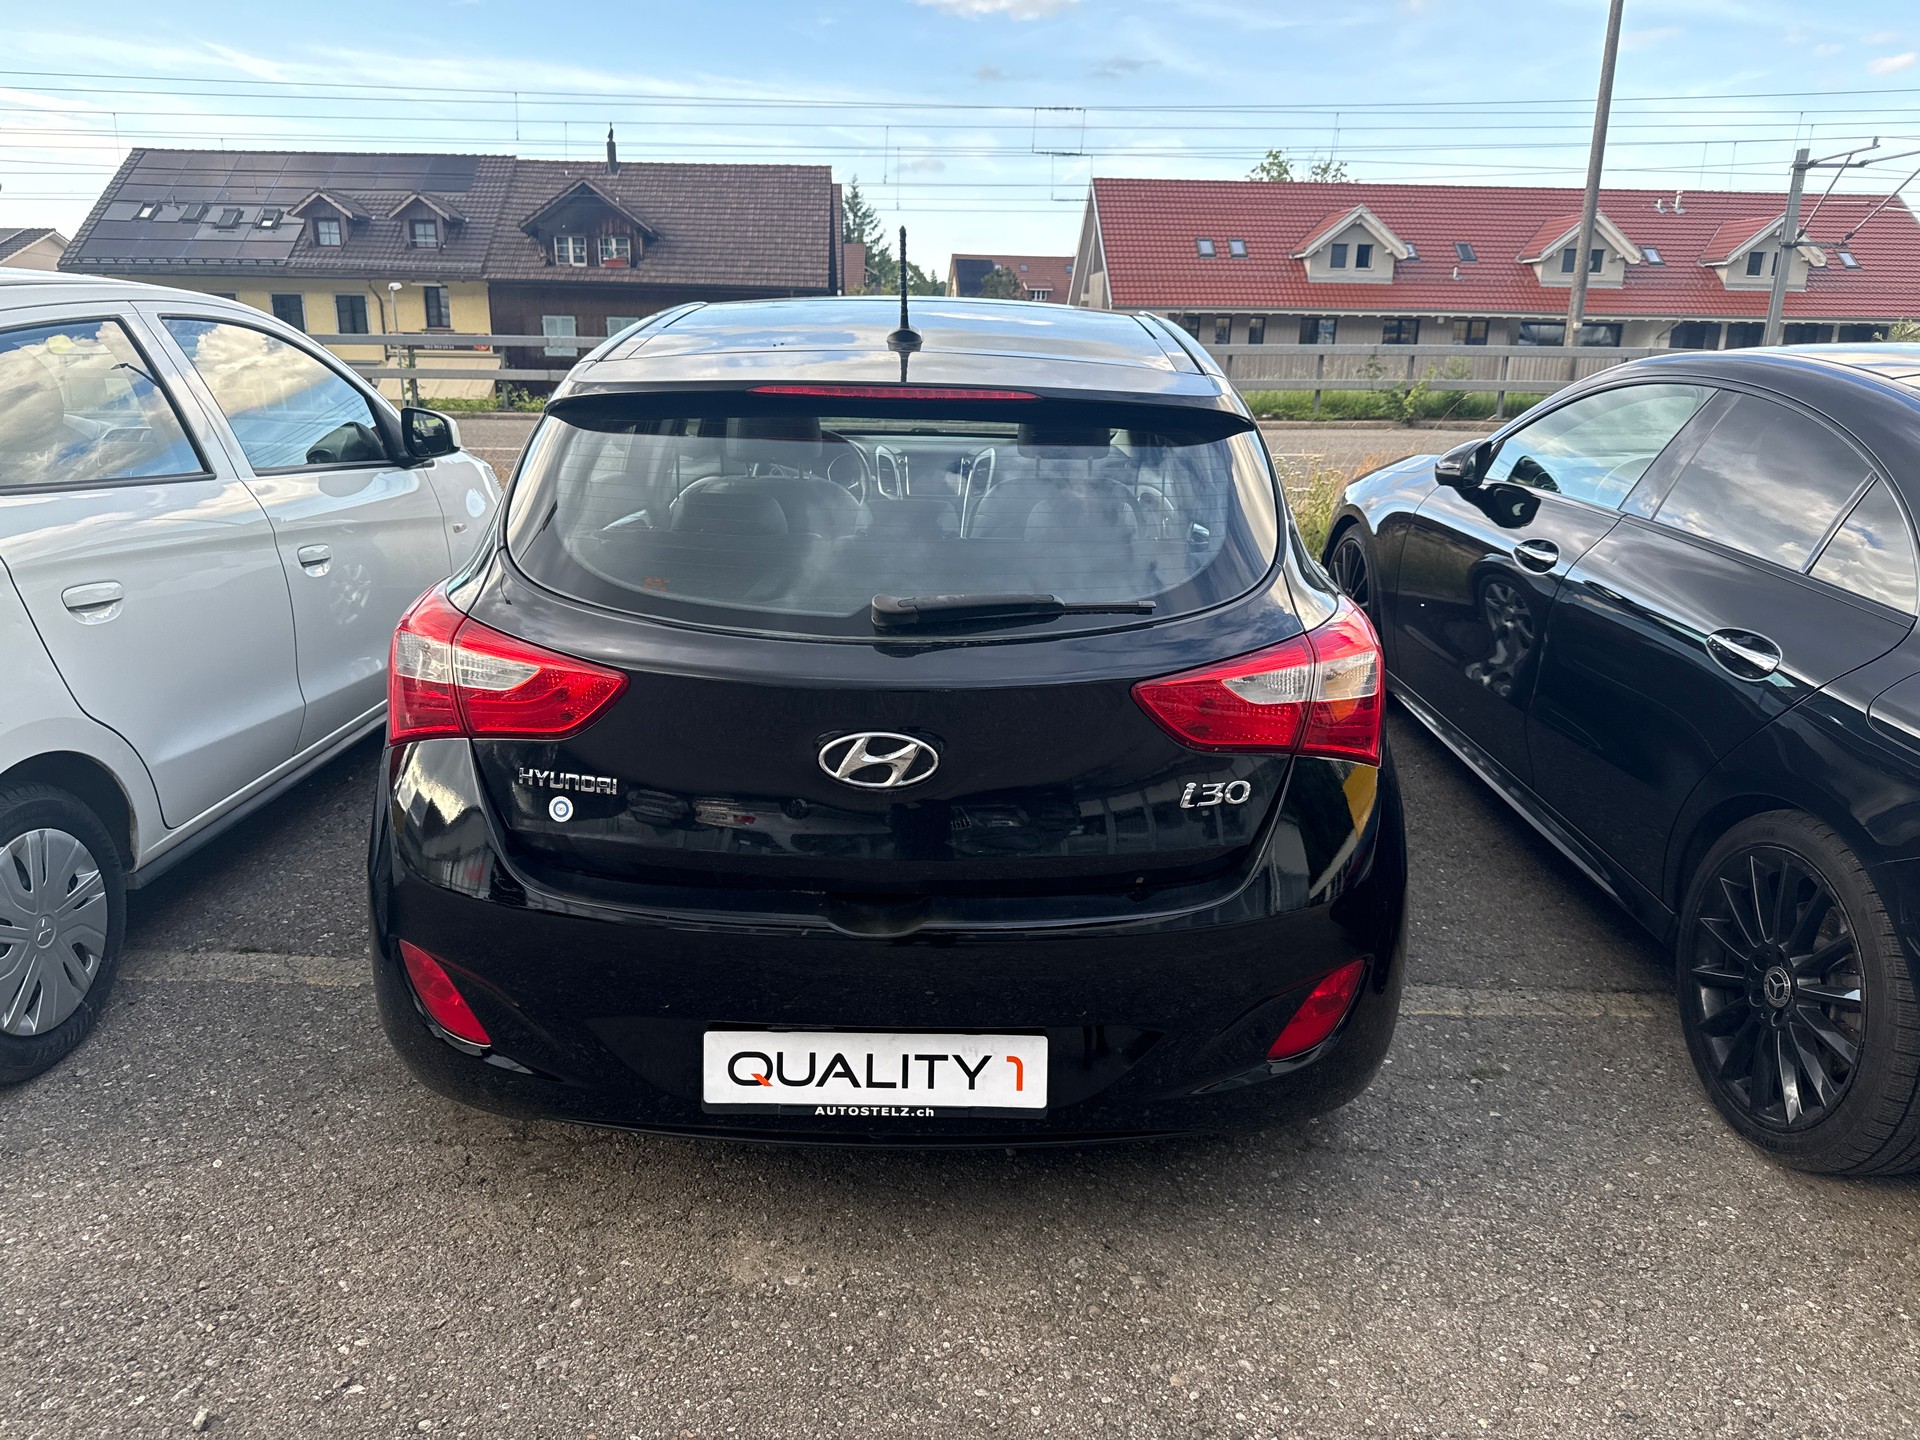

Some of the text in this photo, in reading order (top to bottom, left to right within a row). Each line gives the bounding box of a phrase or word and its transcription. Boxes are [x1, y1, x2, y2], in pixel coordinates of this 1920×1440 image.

[518, 766, 618, 795] HYUNDAI
[1180, 780, 1252, 809] i30
[727, 1051, 1024, 1092] QUALITY 1
[814, 1106, 935, 1117] AUTOSTELZ.ch
